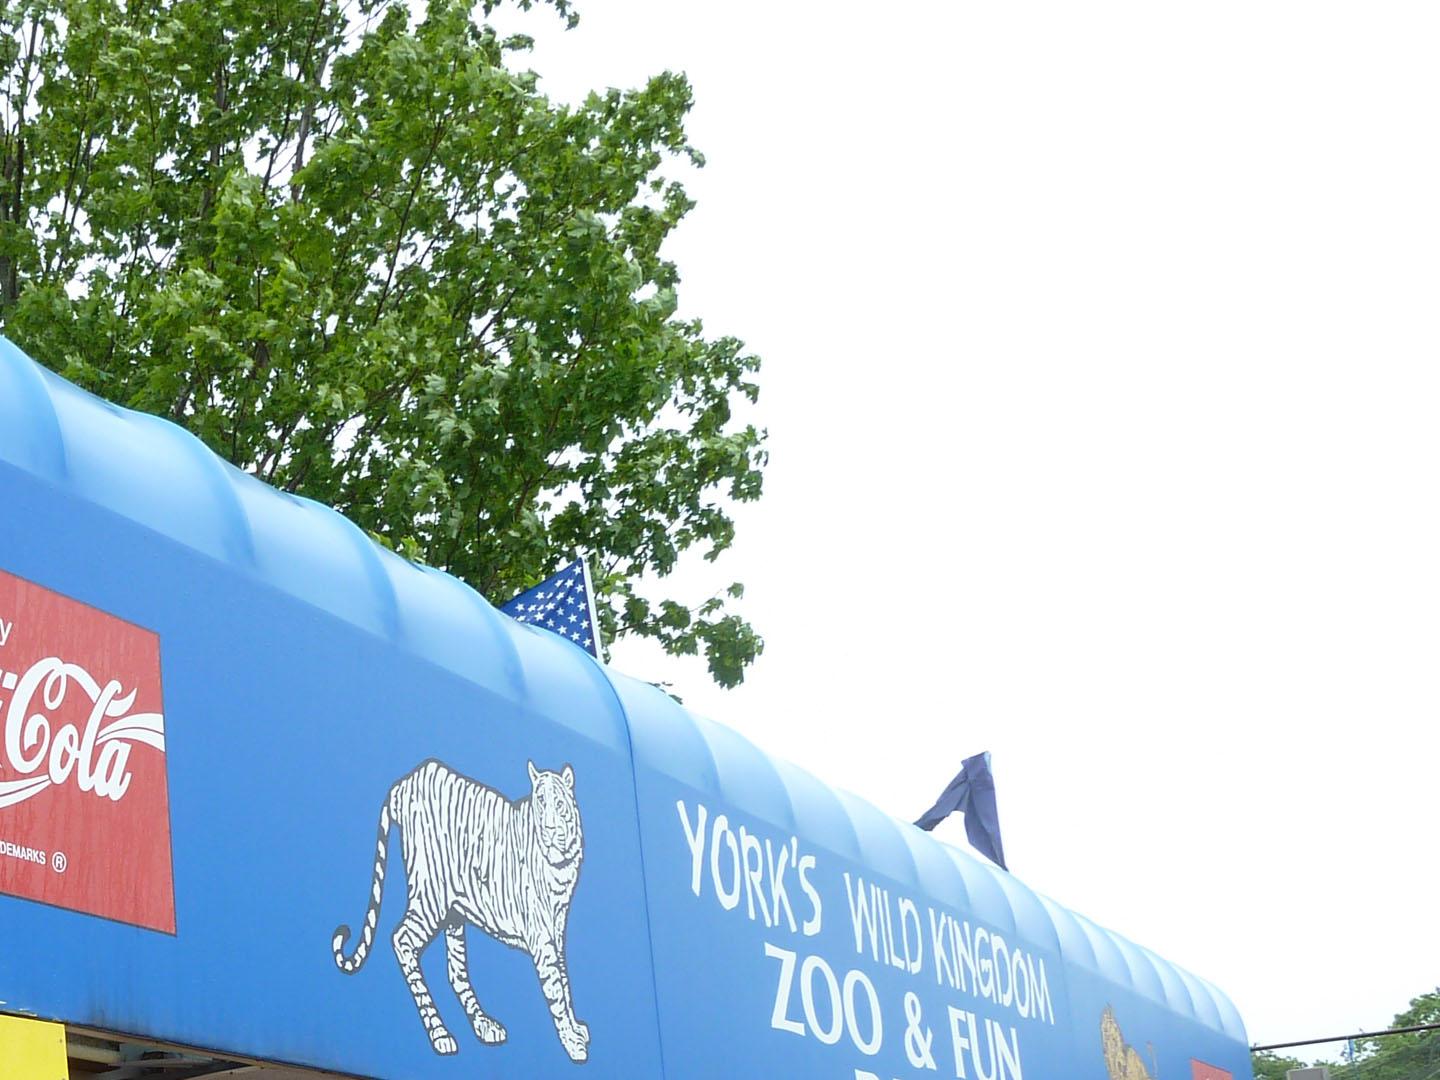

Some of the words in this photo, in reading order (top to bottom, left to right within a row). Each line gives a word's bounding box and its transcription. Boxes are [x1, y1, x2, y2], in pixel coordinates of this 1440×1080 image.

[676, 800, 822, 937] YORK'S
[843, 872, 923, 975] WILD
[928, 907, 1055, 1026] KINGDOM
[764, 942, 884, 1056] ZOO
[904, 991, 937, 1070] &
